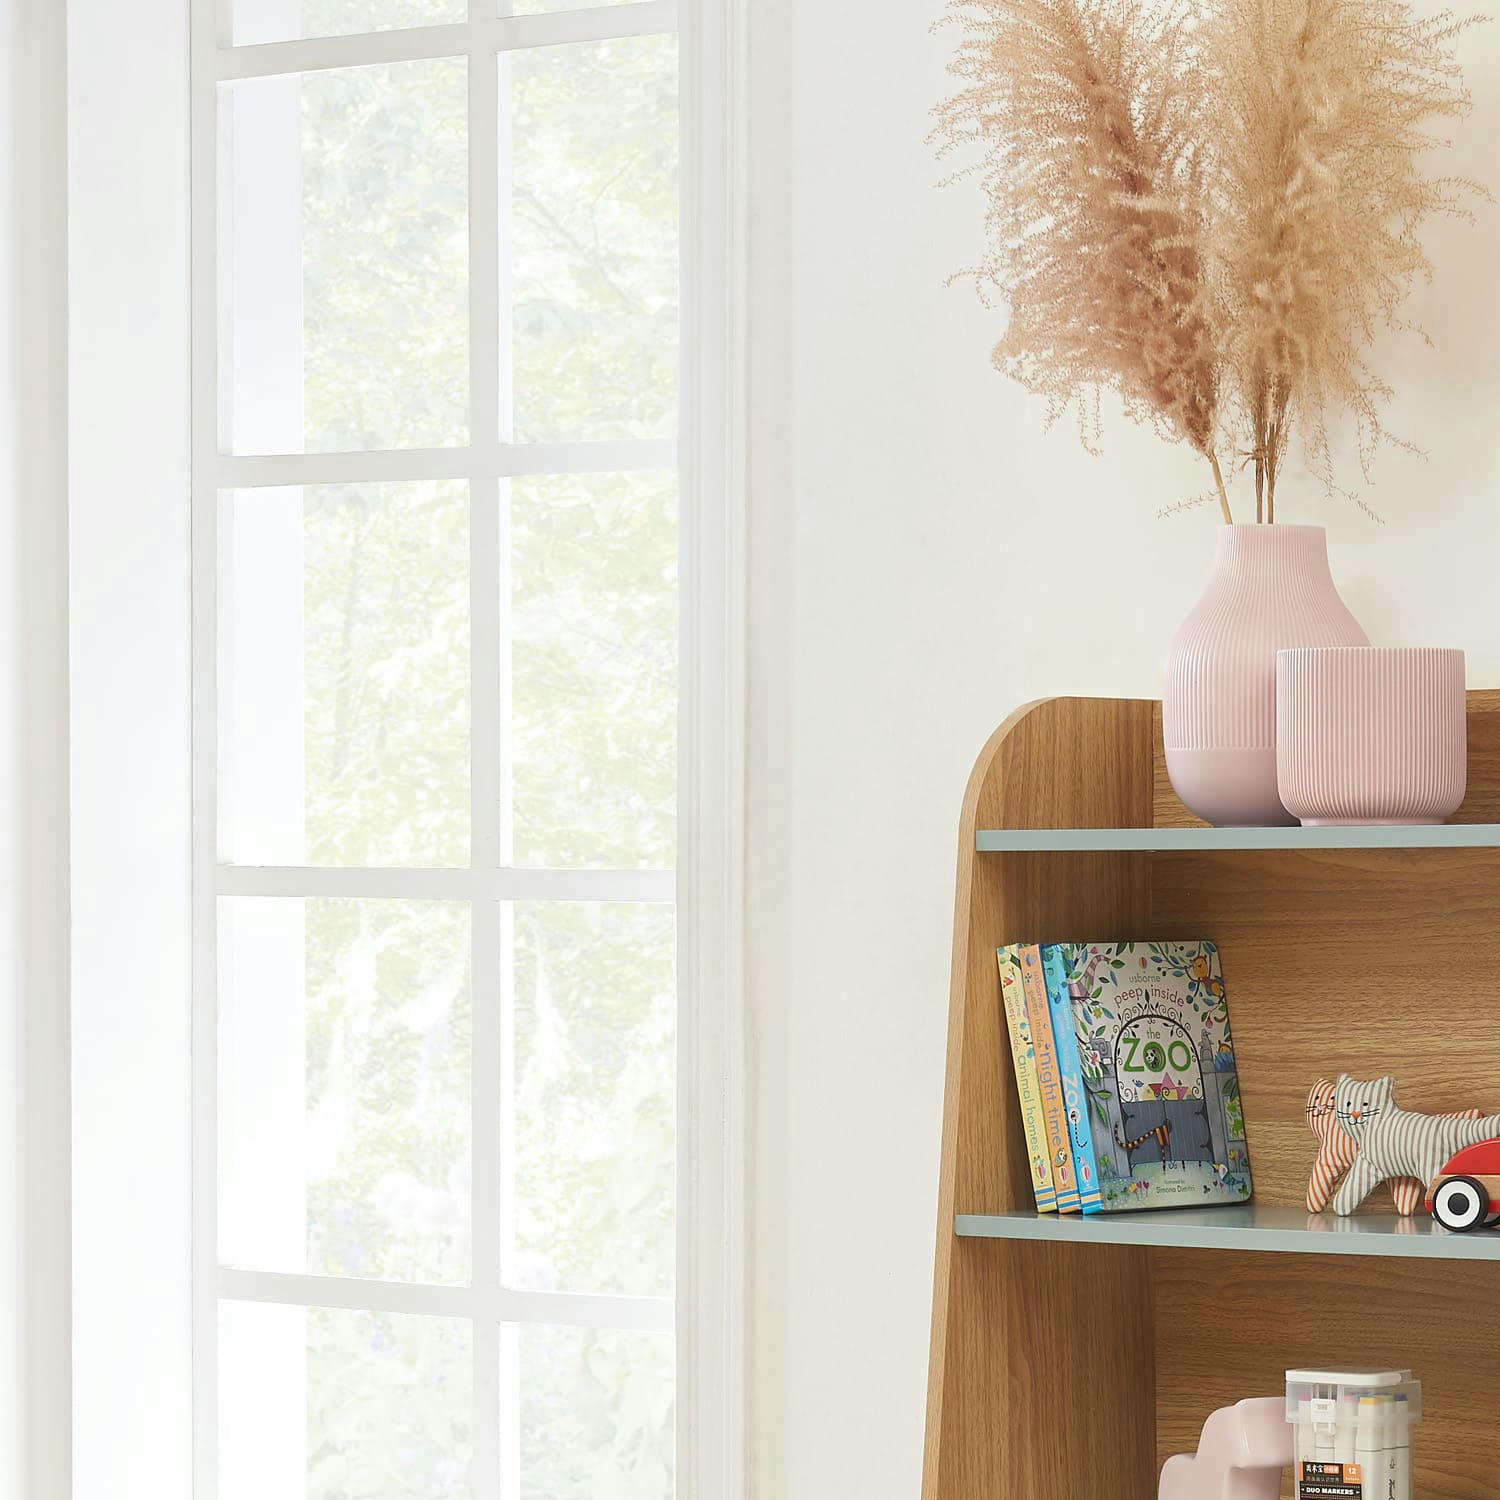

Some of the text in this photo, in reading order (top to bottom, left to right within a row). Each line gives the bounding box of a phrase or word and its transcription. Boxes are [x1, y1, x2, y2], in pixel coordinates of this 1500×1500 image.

[1129, 973, 1160, 983] usborne
[1114, 984, 1185, 1008] peep inside
[1147, 1027, 1160, 1039] the
[1017, 1055, 1039, 1152] animal homes
[1040, 1052, 1062, 1146] night time
[1348, 1467, 1357, 1475] 12
